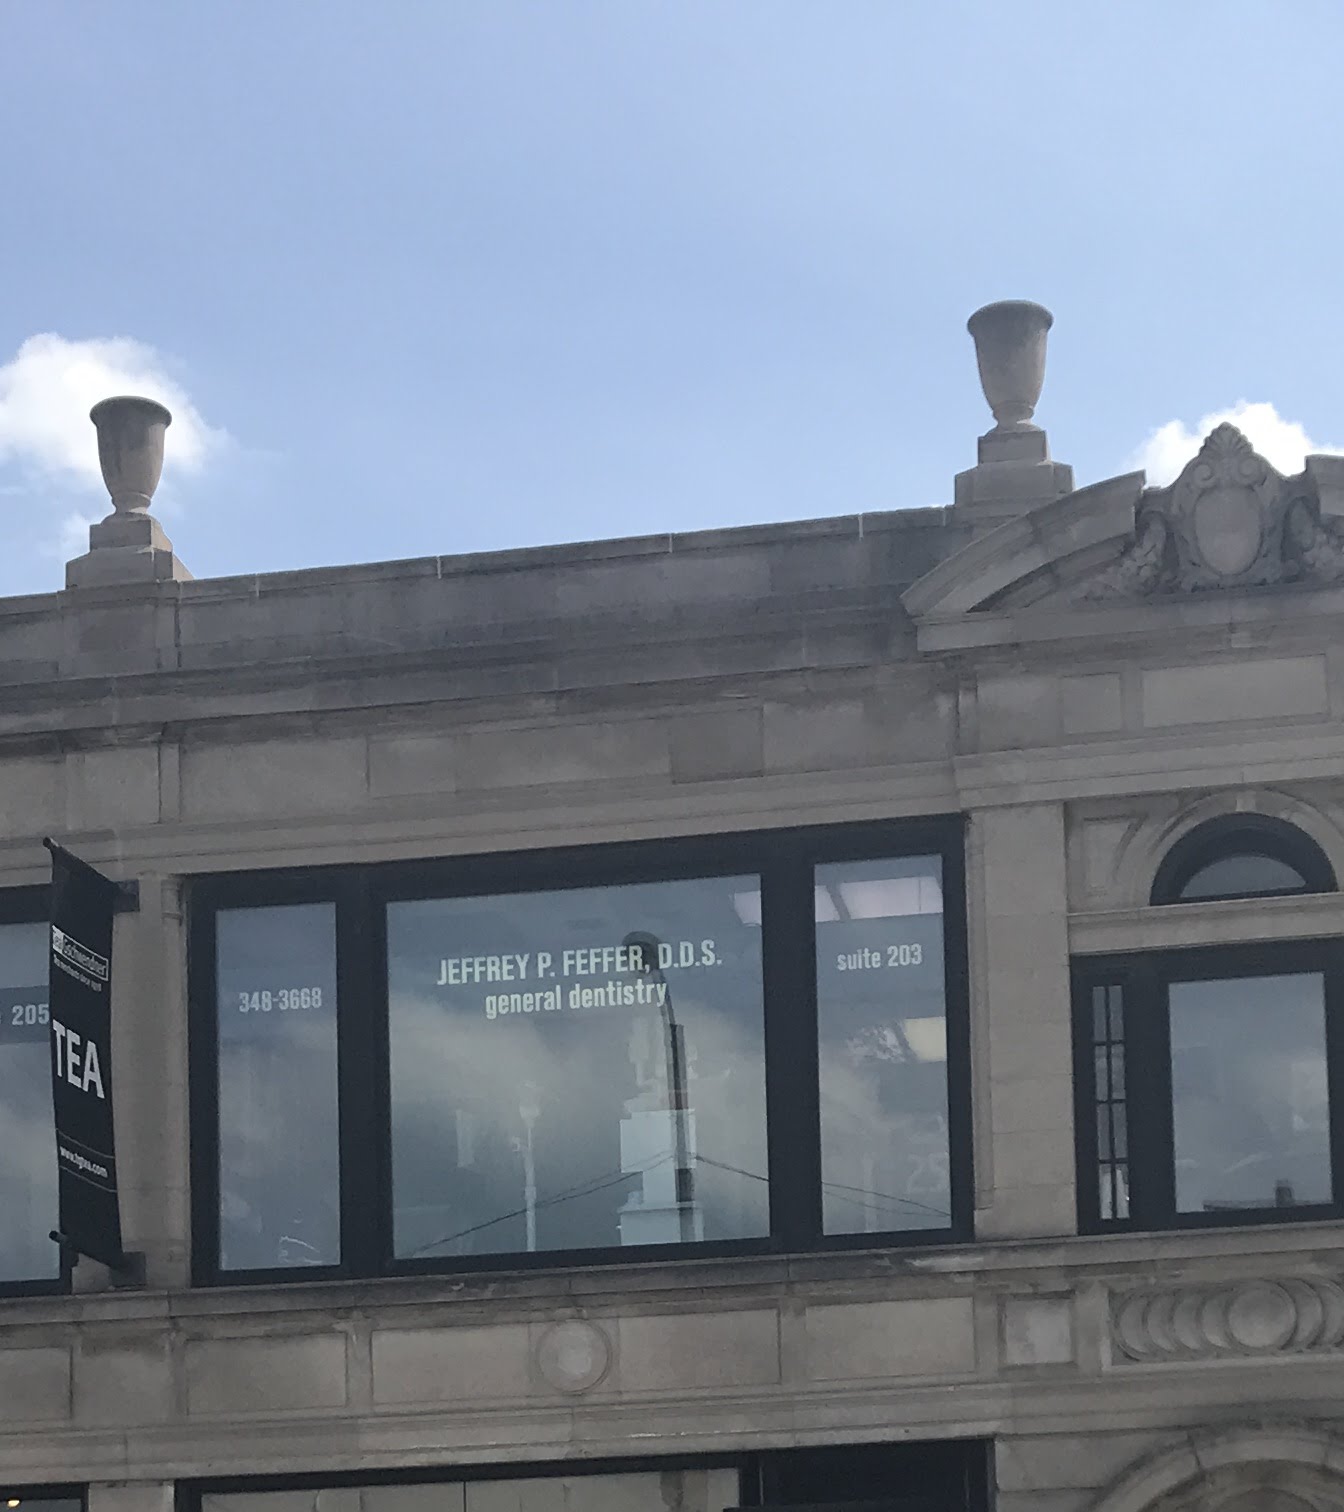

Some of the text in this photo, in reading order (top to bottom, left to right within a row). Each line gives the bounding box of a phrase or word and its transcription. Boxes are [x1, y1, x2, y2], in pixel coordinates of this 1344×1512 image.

[437, 939, 723, 986] JEFFREY P. FEFFER, D.D.S.
[837, 943, 922, 971] suite 203
[11, 1003, 50, 1026] 205
[239, 987, 322, 1012] 348-3668
[485, 978, 667, 1019] general dentistry
[53, 1019, 105, 1098] TEA
